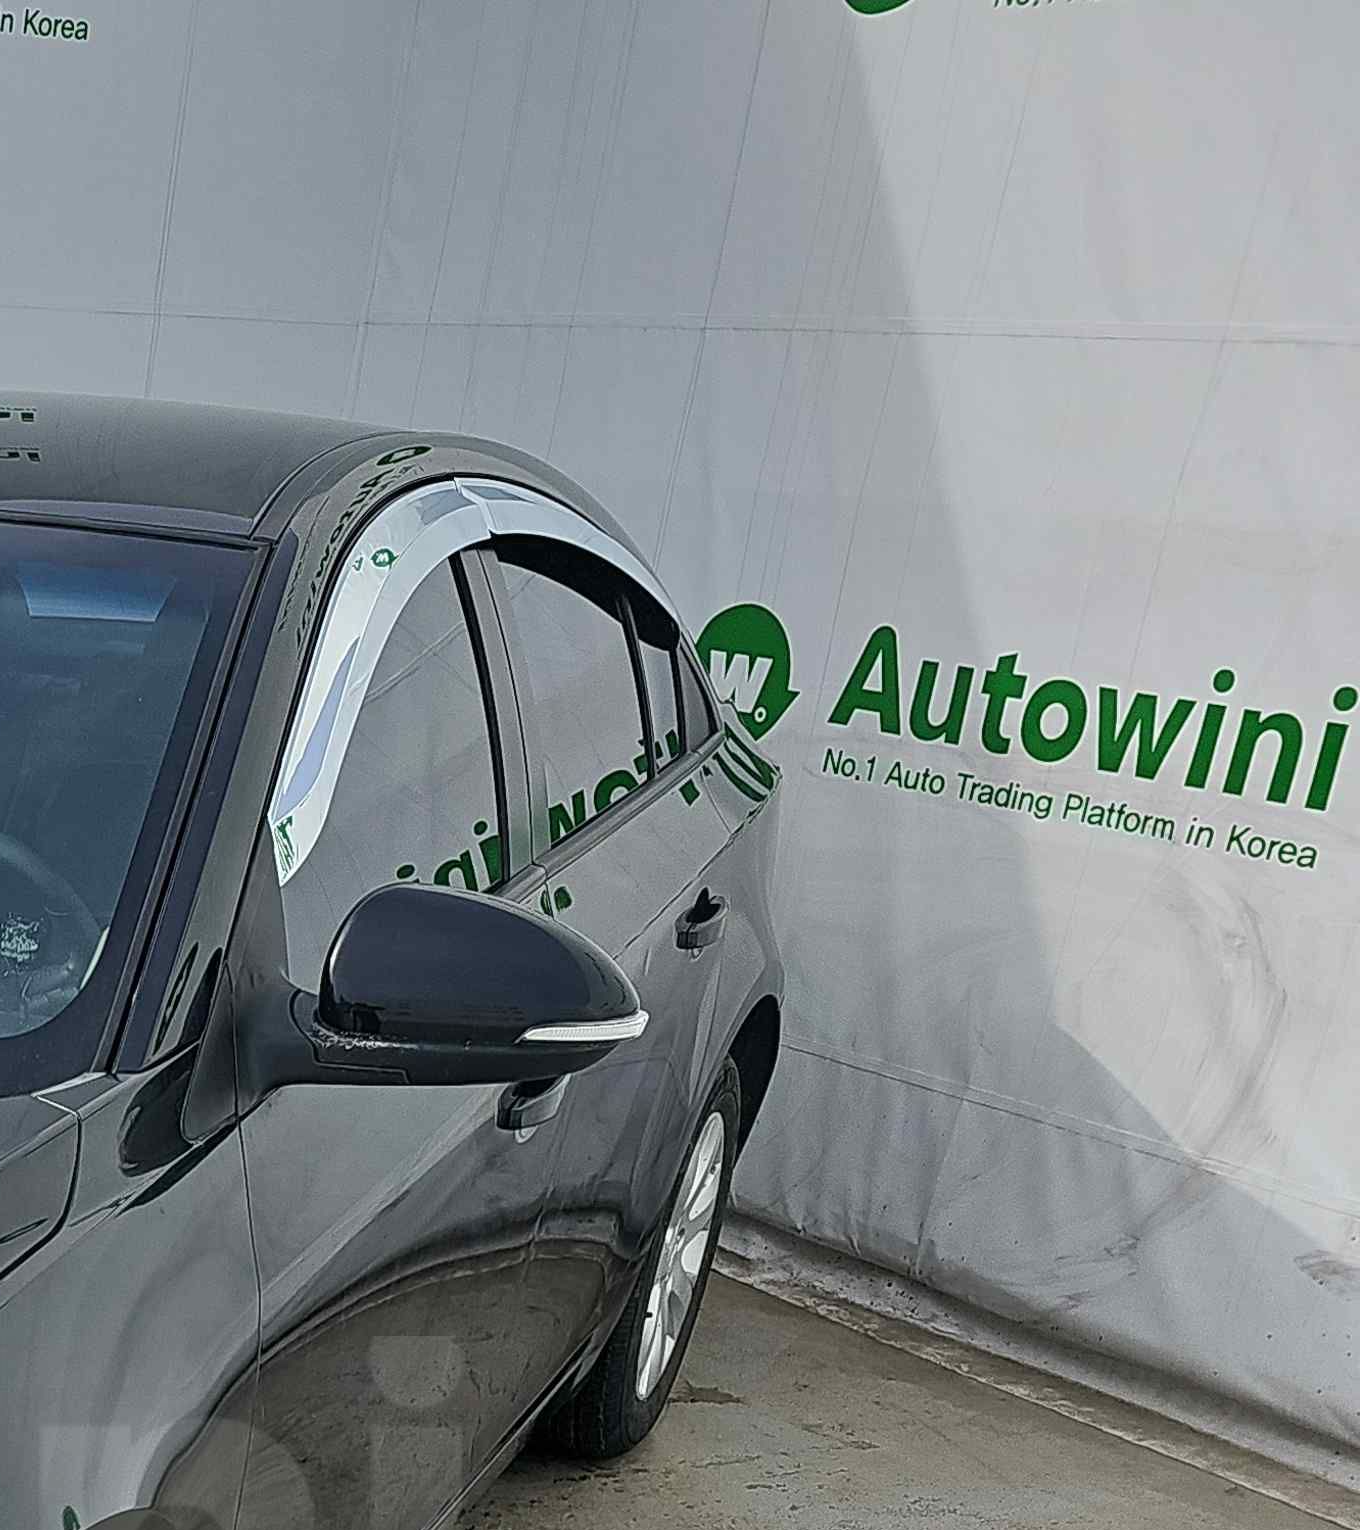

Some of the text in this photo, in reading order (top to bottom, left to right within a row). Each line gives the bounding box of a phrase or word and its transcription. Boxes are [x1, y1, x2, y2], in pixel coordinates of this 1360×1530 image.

[22, 9, 89, 40] Korea
[827, 624, 1359, 812] Autowini
[822, 748, 1319, 869] No.1 Auto Trading Platform in Korea
